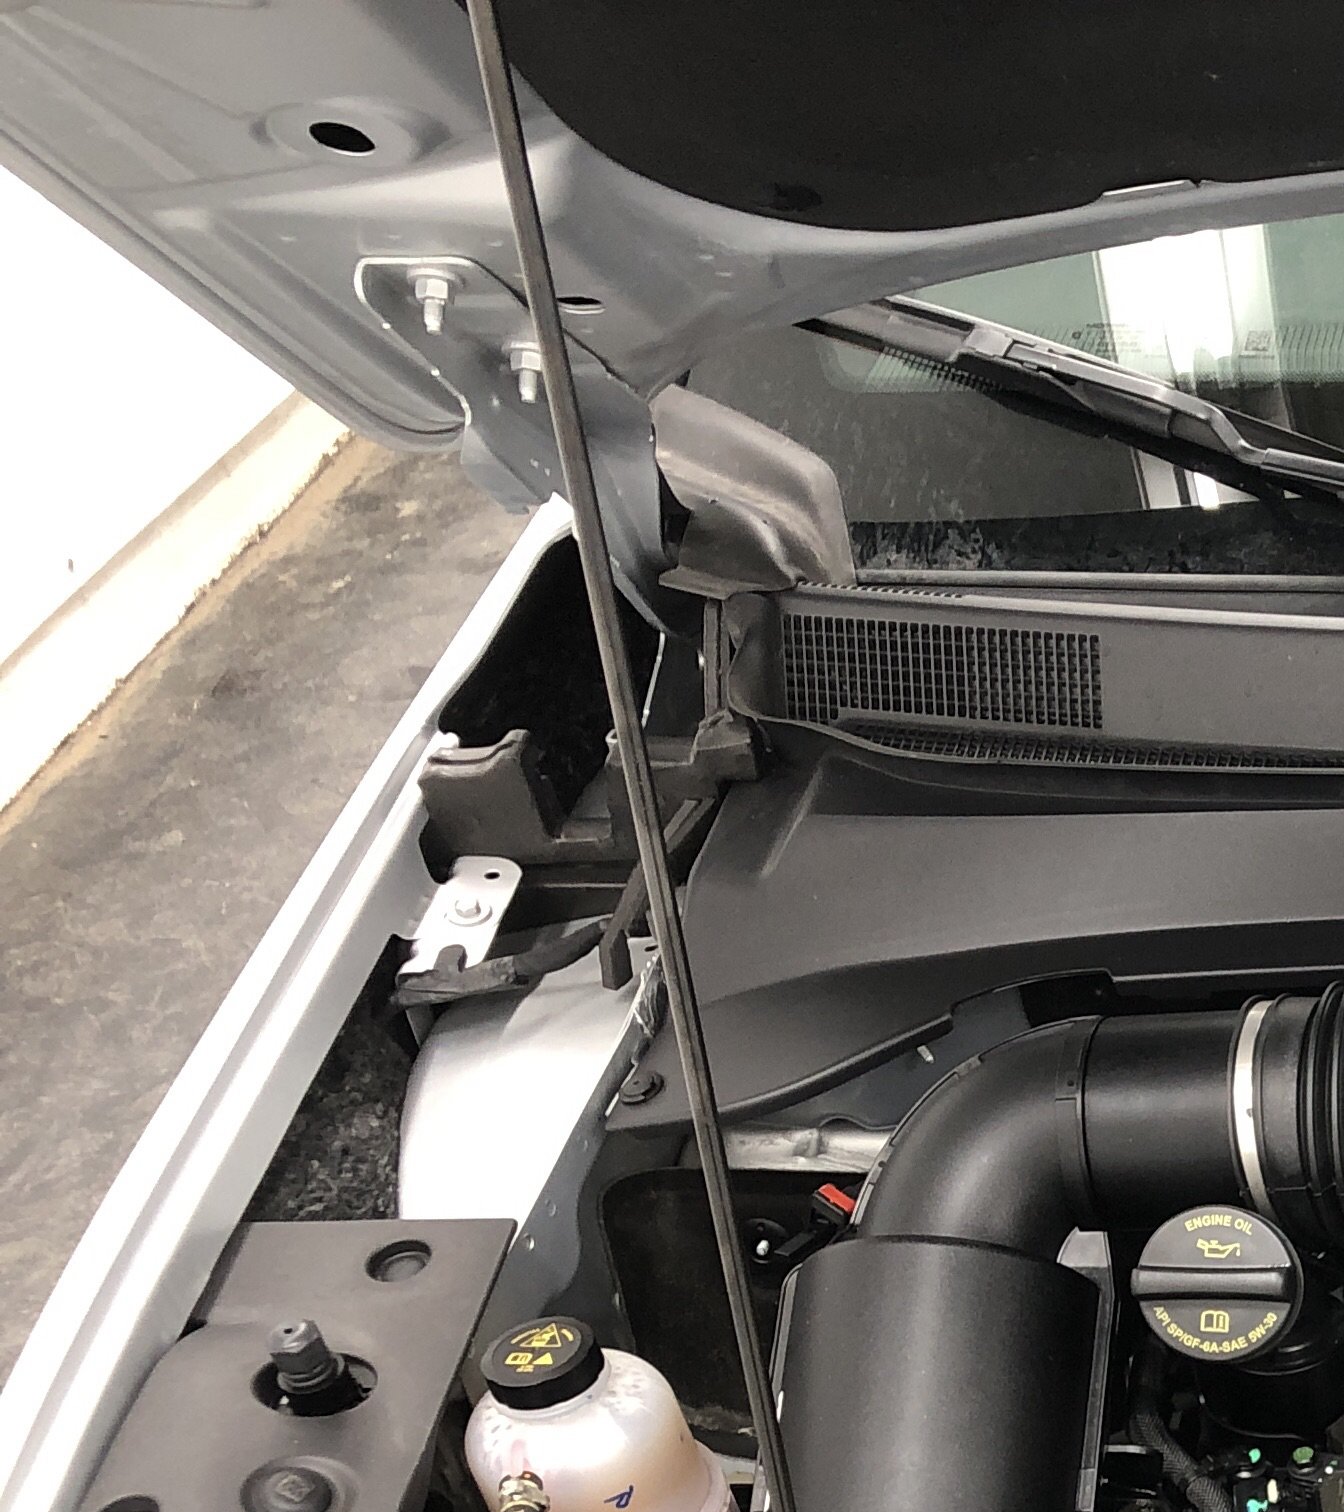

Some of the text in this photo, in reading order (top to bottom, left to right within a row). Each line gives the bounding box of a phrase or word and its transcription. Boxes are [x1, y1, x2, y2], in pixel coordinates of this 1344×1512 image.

[1184, 1214, 1254, 1236] ENGINE OIL
[1153, 1306, 1171, 1327] API
[1248, 1311, 1278, 1343] 5W-30
